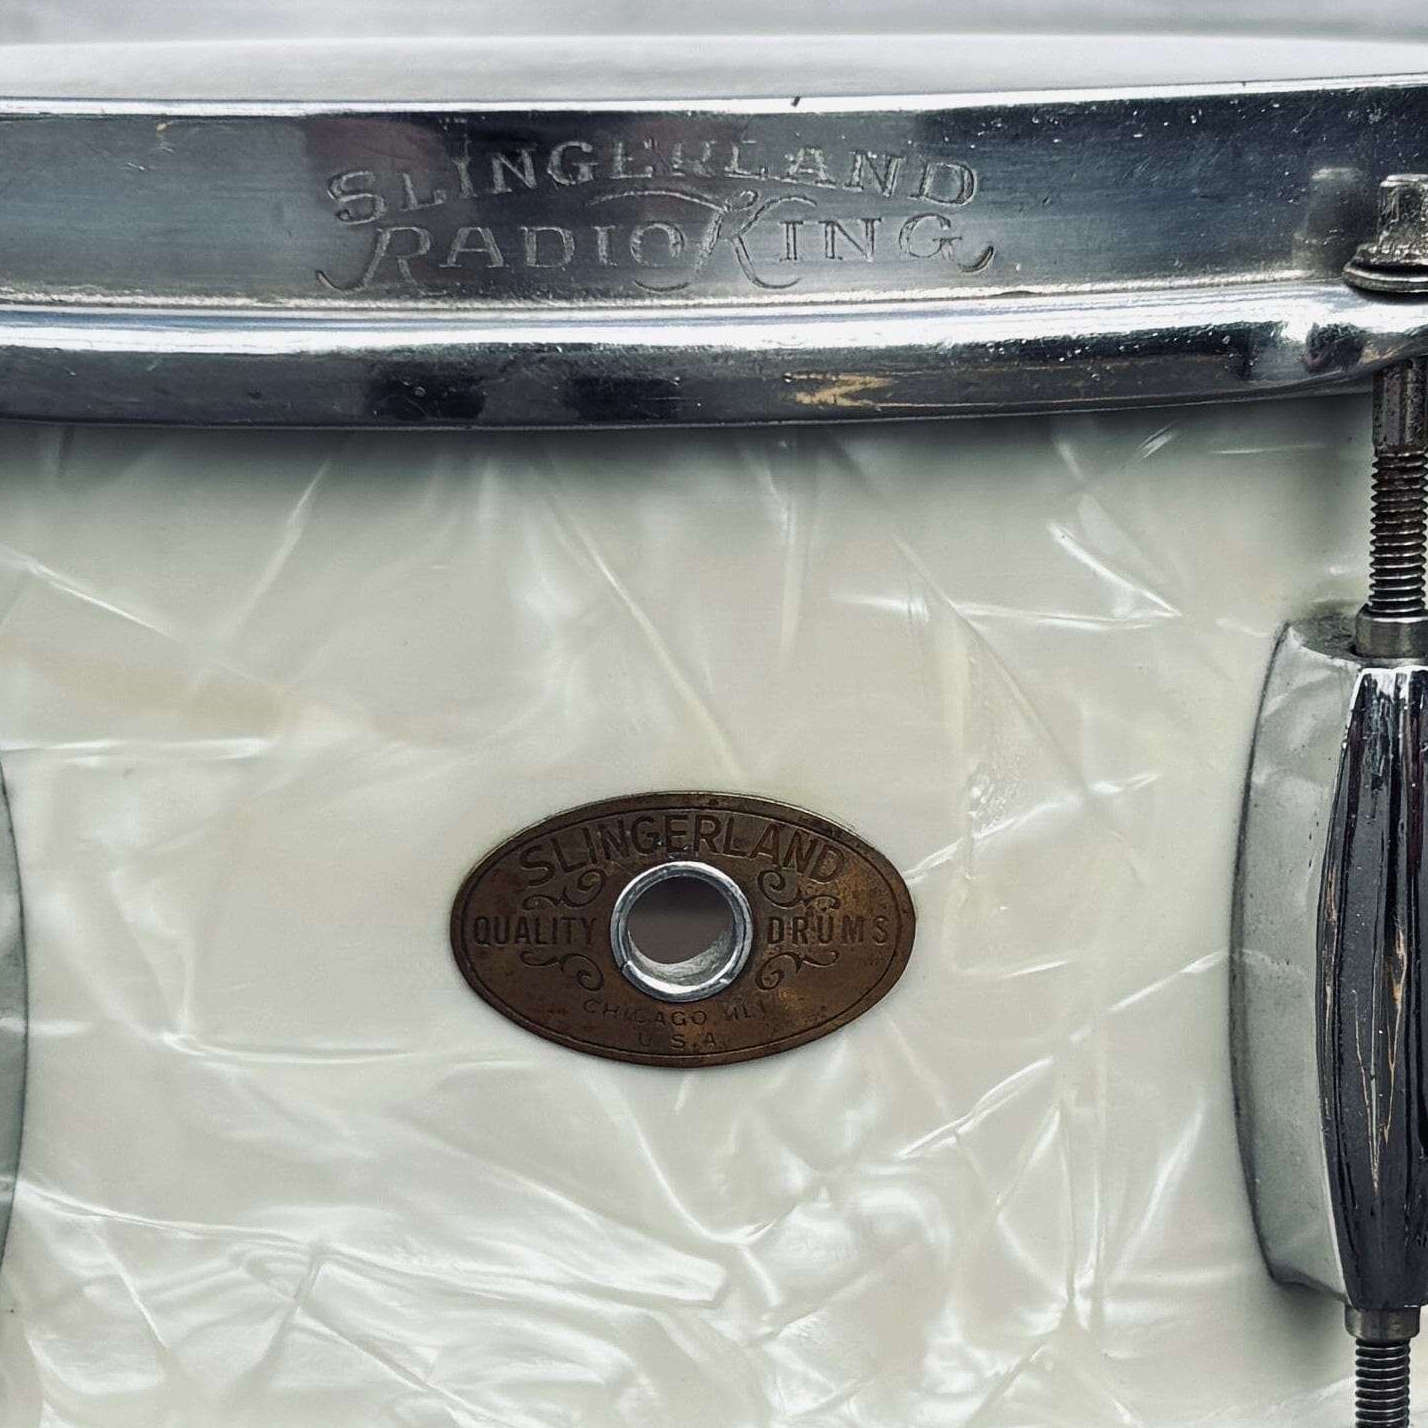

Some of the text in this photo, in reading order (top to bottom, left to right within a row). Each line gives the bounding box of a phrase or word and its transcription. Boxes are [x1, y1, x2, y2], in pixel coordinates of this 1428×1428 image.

[326, 138, 980, 228] SLINGERLAND
[517, 812, 848, 890] SLINGERLAND
[473, 914, 891, 948] QUALITY DRUMS
